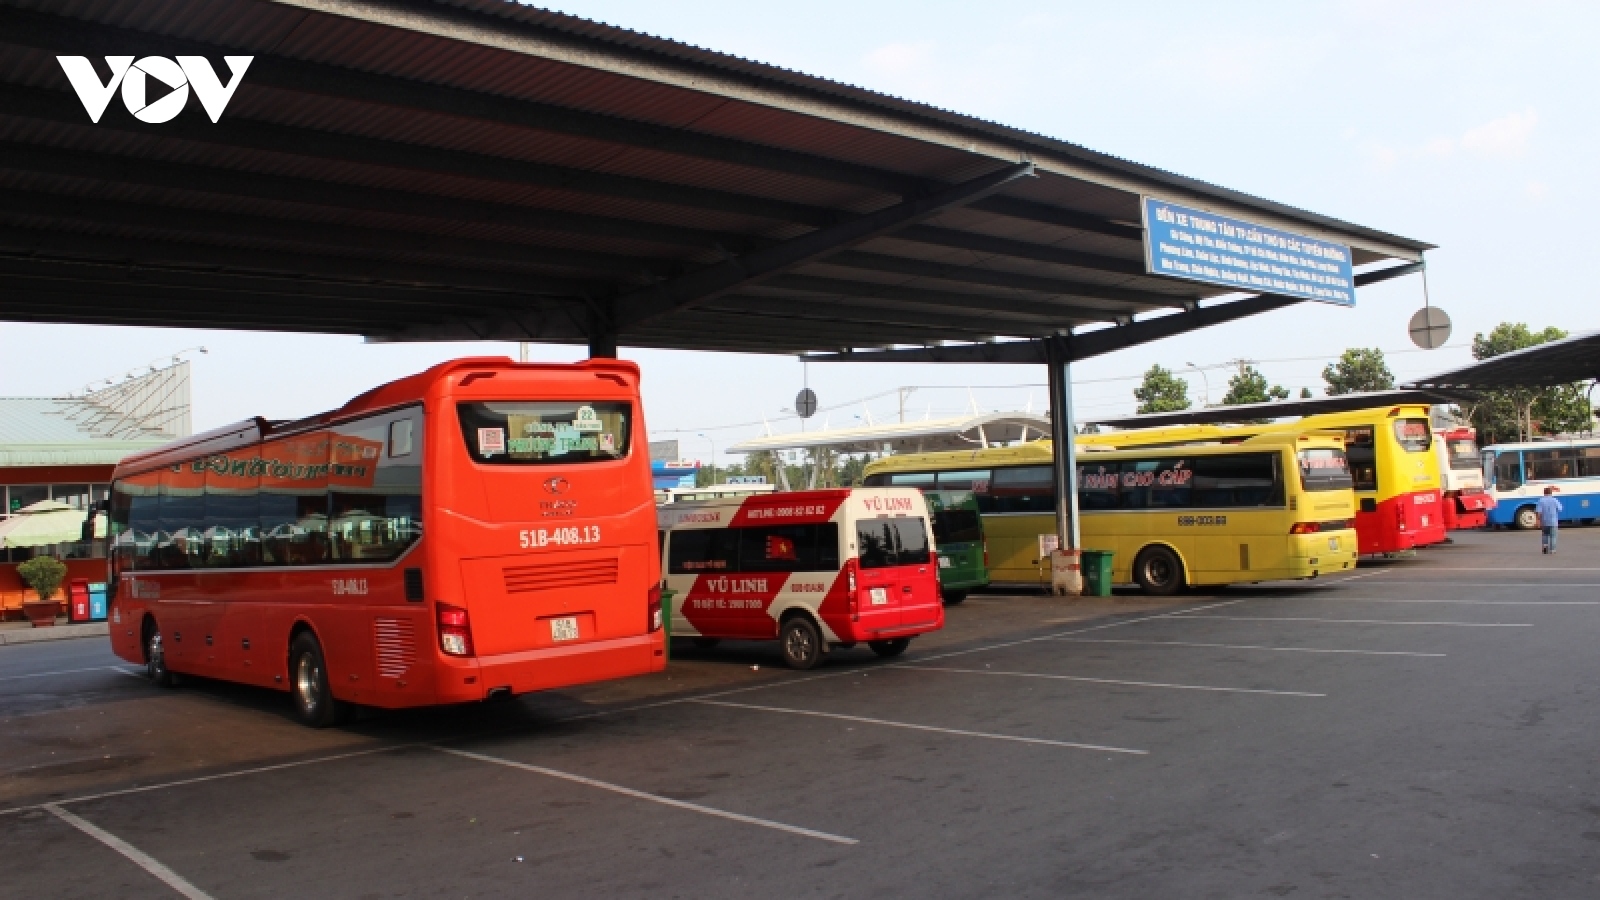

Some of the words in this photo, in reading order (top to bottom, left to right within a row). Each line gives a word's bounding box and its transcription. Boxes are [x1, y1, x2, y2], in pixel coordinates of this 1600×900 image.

[863, 495, 882, 511] VŨ
[883, 497, 912, 511] LINH
[519, 525, 601, 548] 51B-408.13
[707, 575, 730, 593] VŨ
[731, 578, 769, 593] LINH
